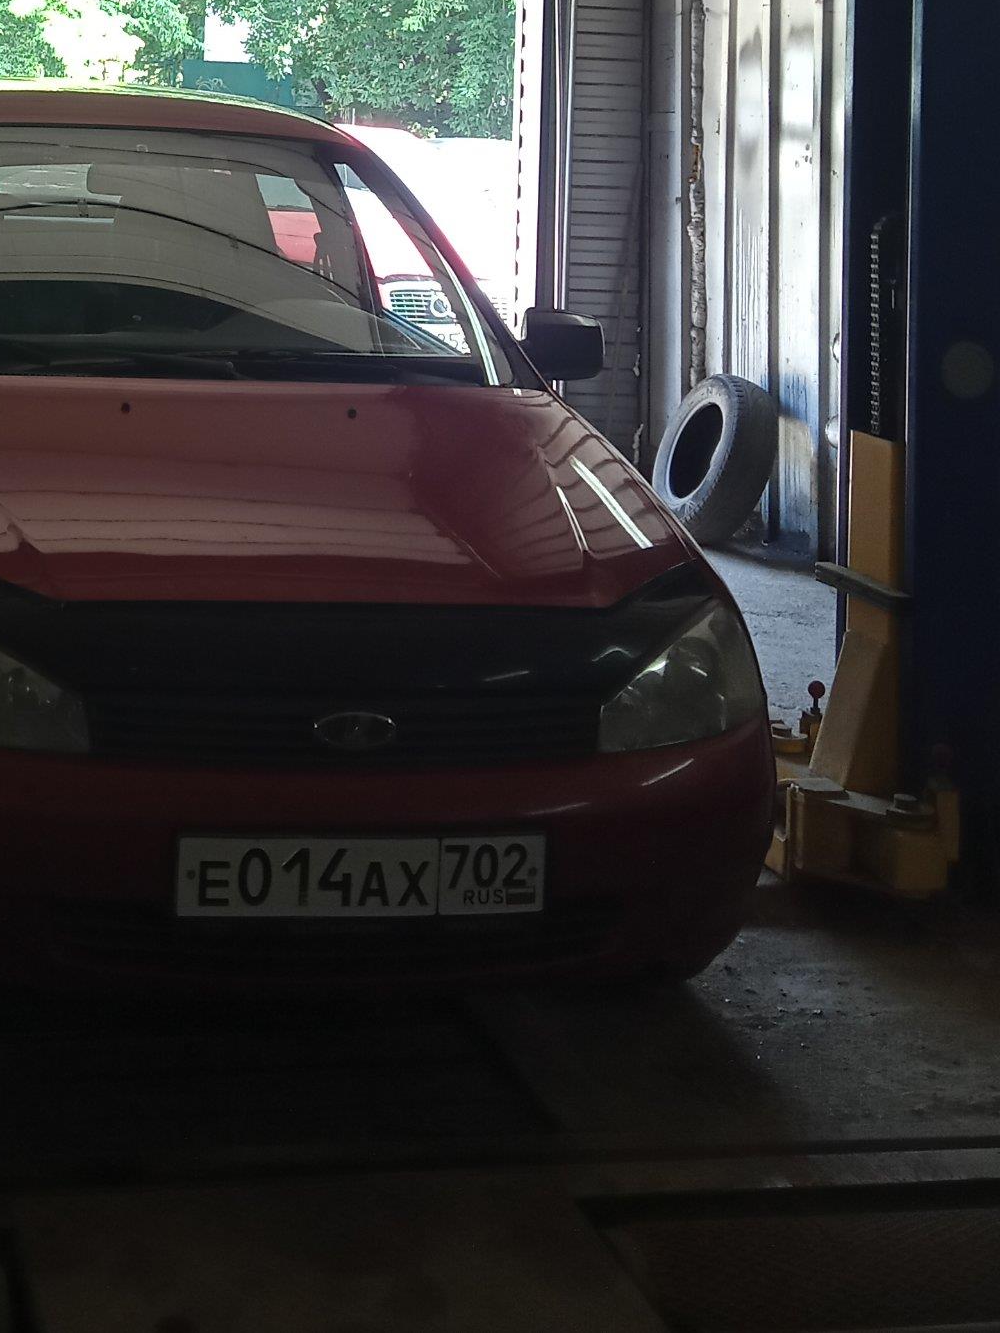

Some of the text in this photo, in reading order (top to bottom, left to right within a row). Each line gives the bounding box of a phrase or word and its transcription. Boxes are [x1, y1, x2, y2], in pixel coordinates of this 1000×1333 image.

[198, 843, 529, 907] E014AX 702
[463, 888, 504, 906] RUS
